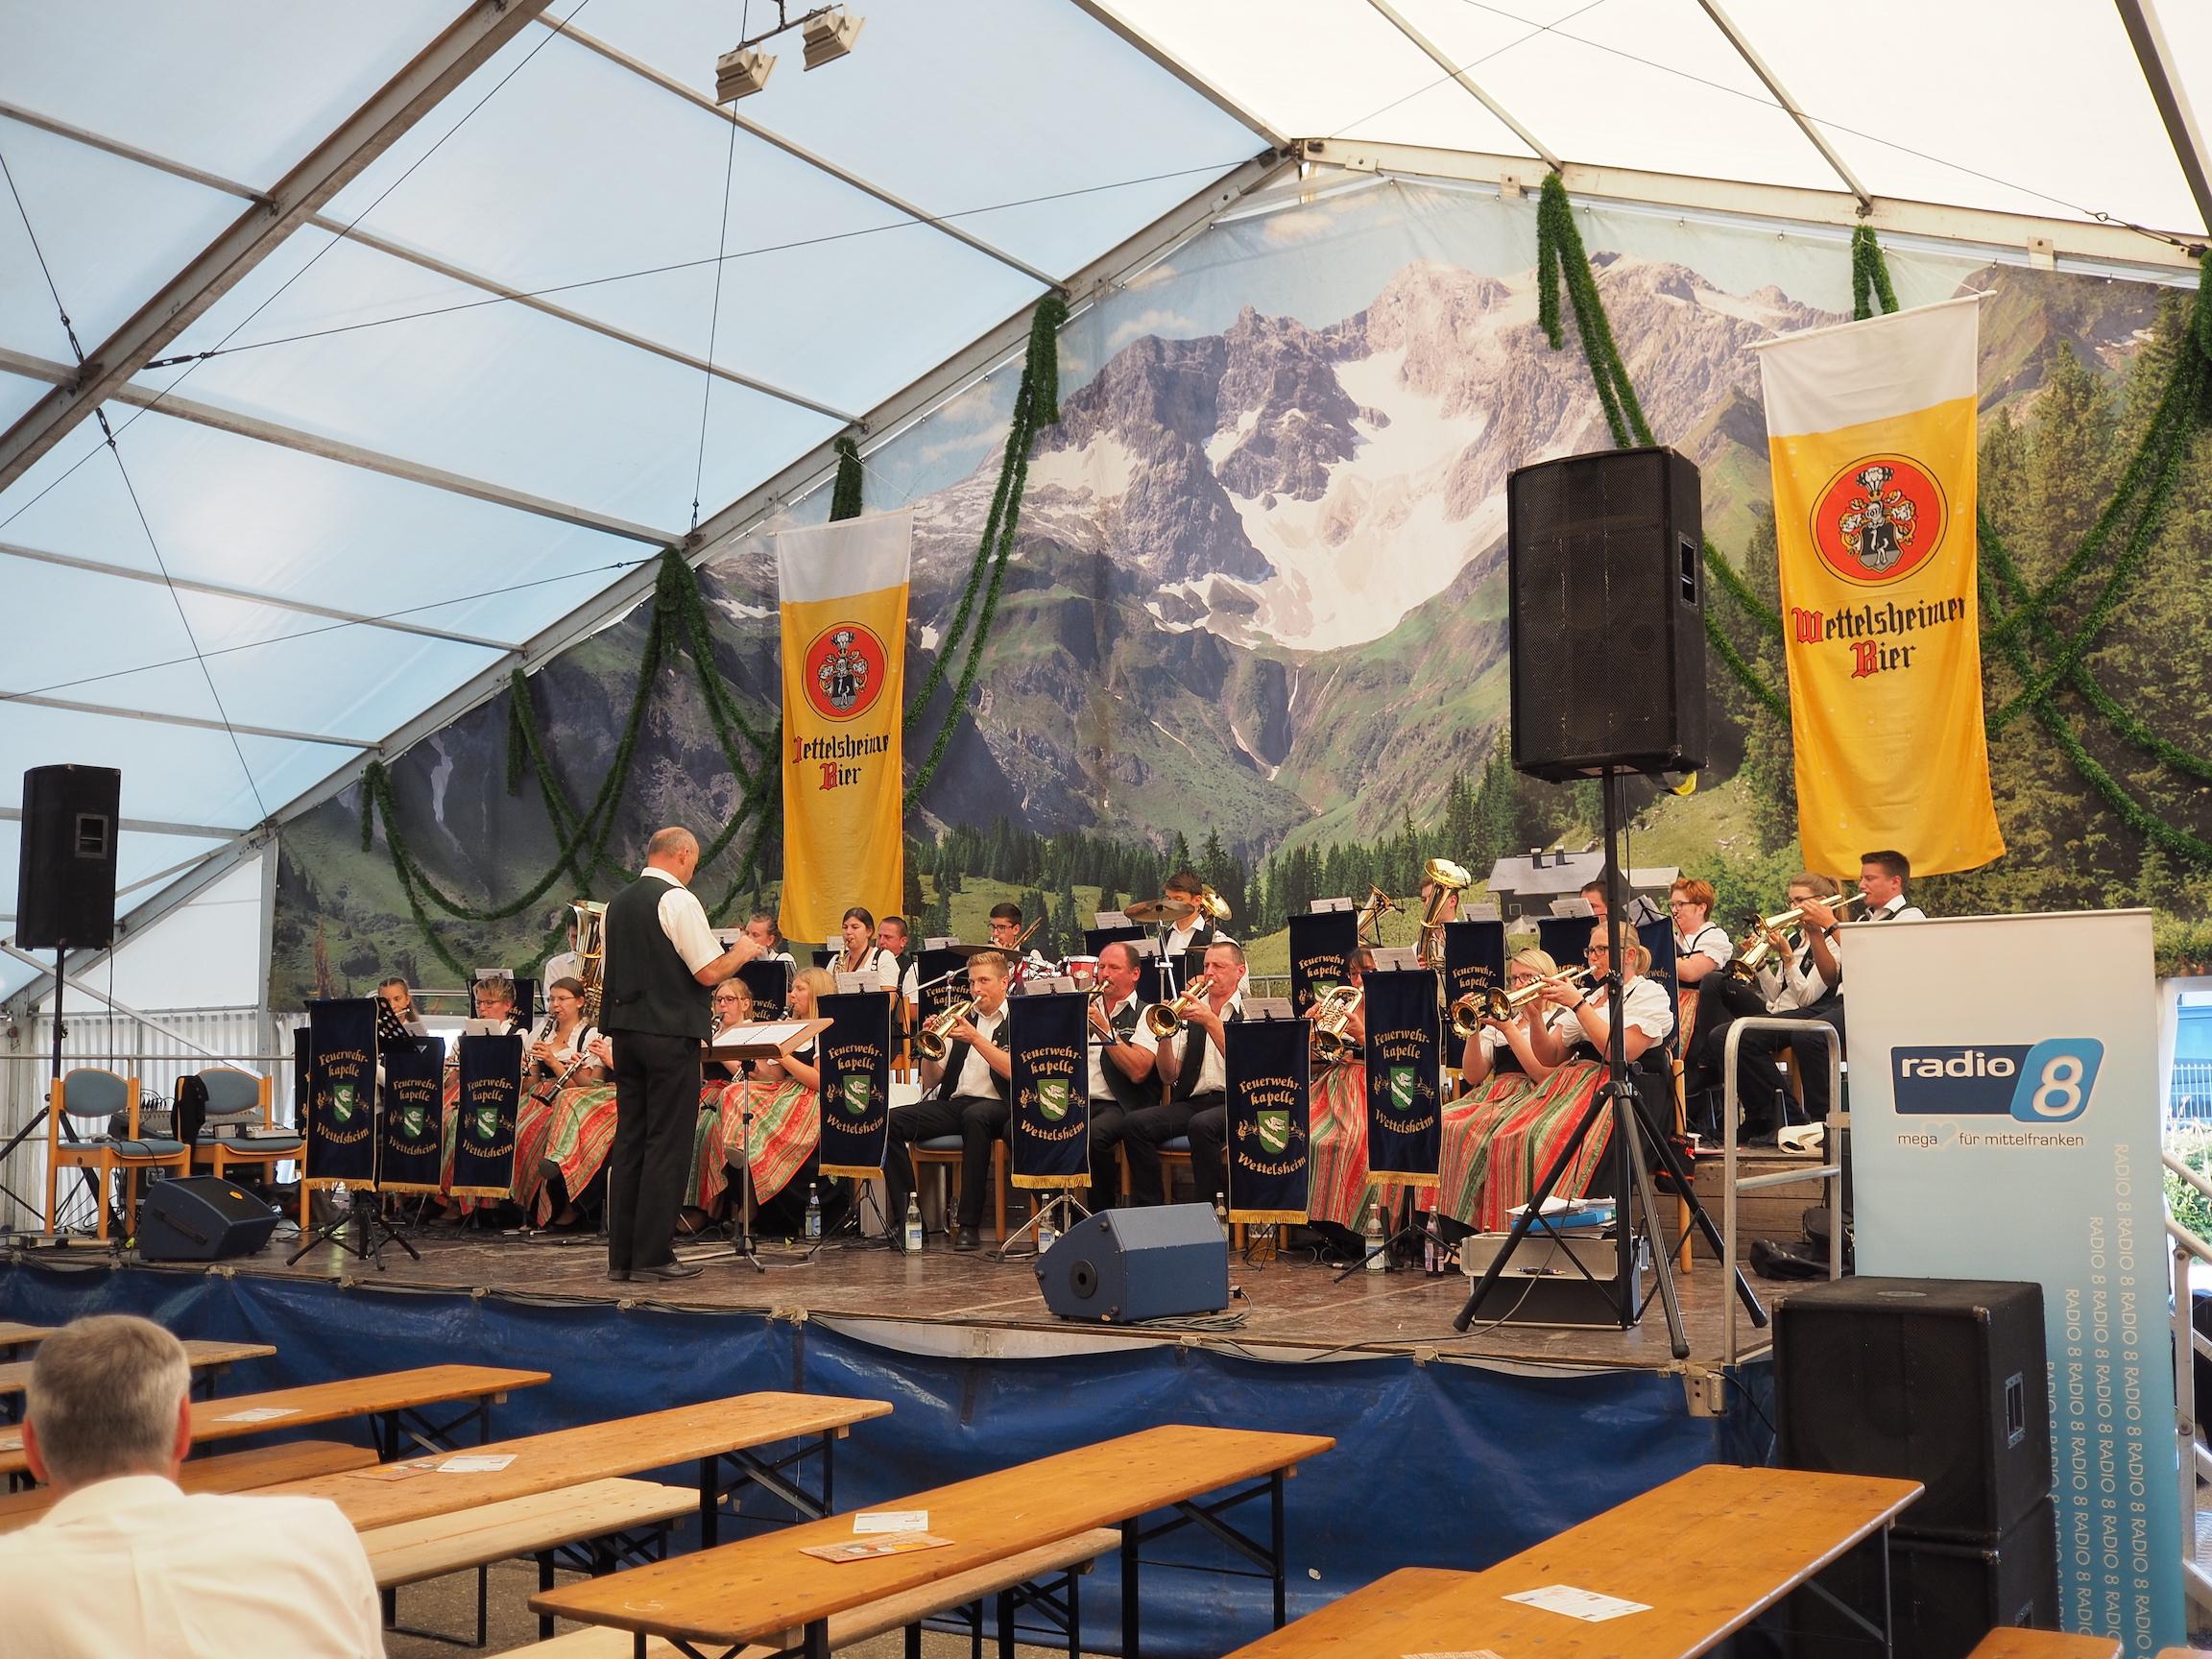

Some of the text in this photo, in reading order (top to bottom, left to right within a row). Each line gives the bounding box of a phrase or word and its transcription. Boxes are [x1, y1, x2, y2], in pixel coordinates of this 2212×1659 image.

[1791, 596, 1966, 644] Wettelsheimer
[1850, 639, 1916, 680] Bier
[819, 761, 862, 791] Bier
[1307, 965, 1342, 978] kapelle
[1459, 976, 1489, 989] kapelle
[1374, 1028, 1431, 1047] Feuerwehr-
[319, 1049, 369, 1067] Feuerwehr-
[828, 1044, 882, 1060] Feuerwehr-
[1021, 1046, 1082, 1064] Feuerwehr-
[1382, 1044, 1420, 1061] kapelle
[328, 1063, 360, 1079] kapelle
[837, 1056, 876, 1071] kapelle
[1030, 1059, 1074, 1075] kapelle
[1238, 1076, 1303, 1094] Feuerwehr-
[1901, 1049, 2083, 1117] radio 8
[399, 1090, 430, 1102] kapelle
[472, 1090, 504, 1103] kapelle
[1250, 1090, 1295, 1107] kapelle
[827, 1114, 884, 1135] Wettelsheim
[1021, 1118, 1085, 1142] Wettelsheim
[1376, 1108, 1433, 1134] Wettelsheim
[317, 1121, 370, 1144] Wettelsheim
[1898, 1132, 2083, 1148] mega für mittelfranken
[389, 1136, 437, 1156] Wettelsheim
[463, 1139, 514, 1158] Wettelsheim
[1238, 1151, 1306, 1176] Wettelsheim
[2114, 1144, 2131, 1196] RADIO
[2117, 1202, 2131, 1213] 8
[2089, 1216, 2105, 1269] RADIO
[2118, 1217, 2134, 1271] RADIO
[2092, 1275, 2106, 1285] 8
[2120, 1276, 2135, 1286] 8
[2066, 1289, 2081, 1342] RADIO
[2093, 1290, 2109, 1343] RADIO
[2121, 1292, 2138, 1345] RADIO
[2067, 1347, 2082, 1357] 8
[2095, 1349, 2110, 1358] 8
[2124, 1351, 2139, 1360] 8
[2068, 1362, 2084, 1415] RADIO
[2096, 1364, 2112, 1418] RADIO
[2125, 1367, 2142, 1421] RADIO
[2071, 1421, 2085, 1431] 8
[2098, 1424, 2113, 1433] 8
[2127, 1427, 2142, 1436] 8
[2071, 1437, 2088, 1490] RADIO
[2099, 1440, 2116, 1494] RADIO
[2128, 1442, 2145, 1497] RADIO
[2074, 1496, 2088, 1506] 8
[2102, 1499, 2117, 1509] 8
[2130, 1503, 2146, 1512] 8
[2074, 1512, 2091, 1566] RADIO
[2103, 1515, 2119, 1569] RADIO
[2130, 1519, 2149, 1573] RADIO
[2077, 1572, 2091, 1581] 8
[2104, 1575, 2120, 1585] 8
[2133, 1578, 2150, 1589] 8
[2135, 1596, 2152, 1649] RADIO
